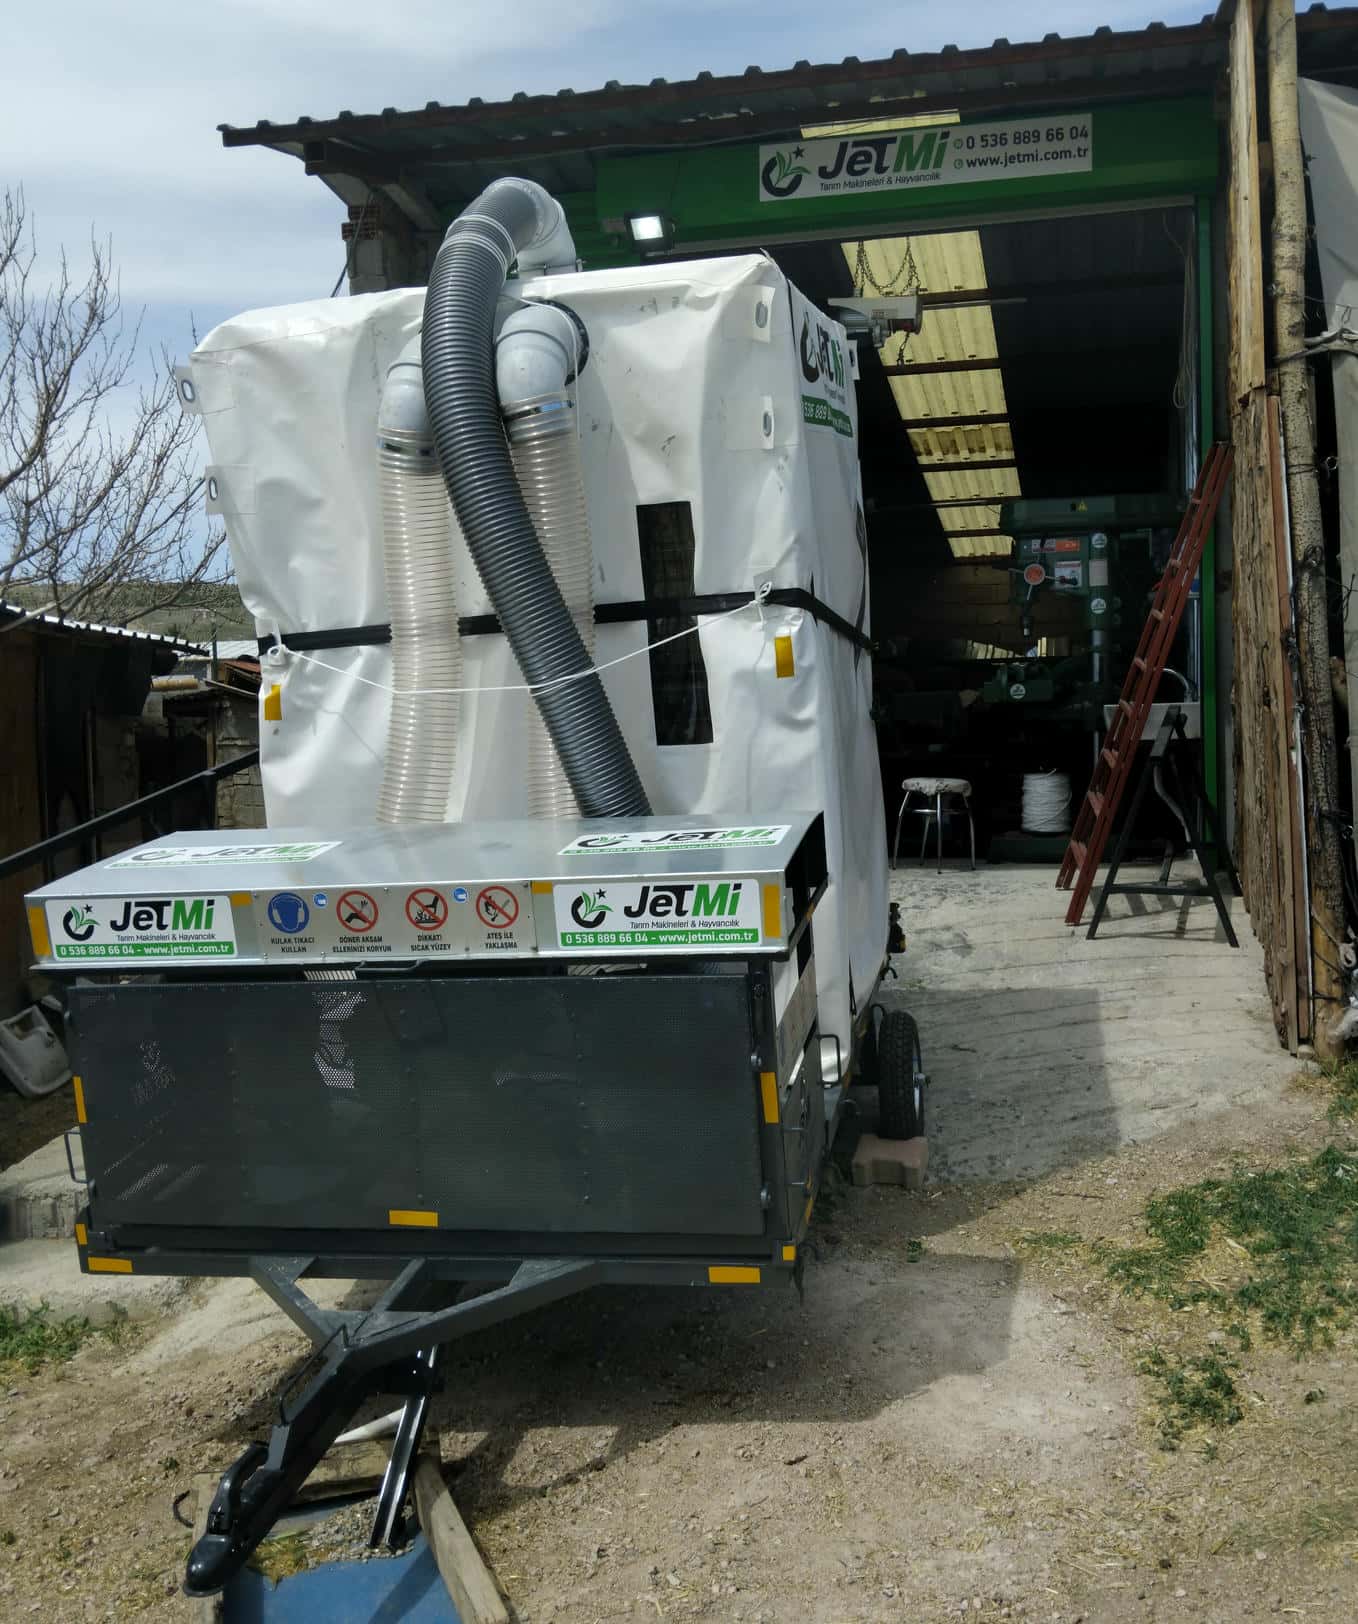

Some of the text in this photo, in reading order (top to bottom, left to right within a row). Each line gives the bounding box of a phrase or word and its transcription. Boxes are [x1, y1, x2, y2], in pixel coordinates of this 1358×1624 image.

[966, 125, 1089, 149] 0 536 889 66 04
[966, 146, 1089, 168] www.jetmi.com.tr
[843, 177, 885, 191] Makineleri
[887, 176, 894, 185] &
[895, 171, 941, 185] Hayvancılık
[651, 920, 688, 928] Makineleri
[690, 920, 697, 928] &
[698, 919, 740, 928] Hayvancılık
[137, 933, 170, 941] Makineleri
[171, 933, 177, 941] &
[179, 932, 216, 941] Hayvancılık
[271, 936, 294, 945] KULAK
[339, 935, 361, 943] DÖNER
[566, 935, 572, 944] 0
[574, 934, 594, 944] 536
[597, 934, 616, 943] 889
[619, 933, 632, 943] 66
[634, 933, 649, 943] 04
[658, 931, 754, 945] www.jetmi.com.tr
[61, 946, 67, 955] 0
[70, 946, 88, 955] 536
[90, 946, 107, 955] 889
[109, 945, 121, 954] 66
[122, 945, 136, 954] 04
[143, 943, 229, 956] www.jetmi.com.tr
[366, 945, 392, 953] KORYUN
[431, 943, 451, 951] YÜZEY
